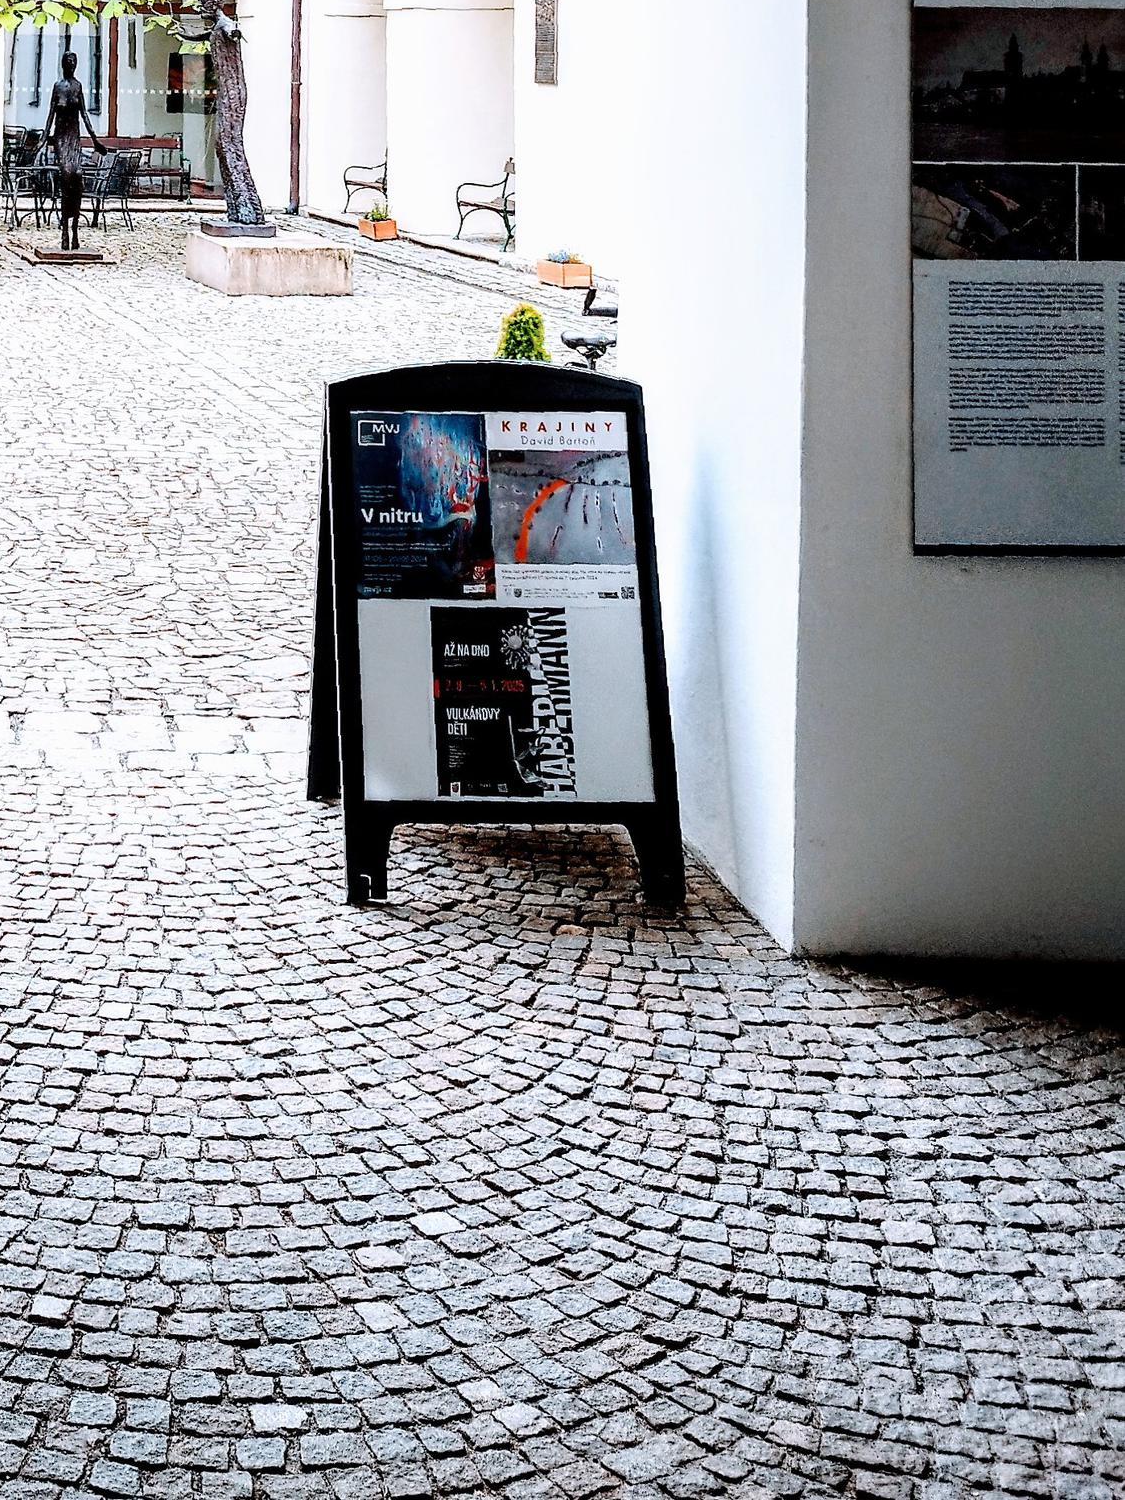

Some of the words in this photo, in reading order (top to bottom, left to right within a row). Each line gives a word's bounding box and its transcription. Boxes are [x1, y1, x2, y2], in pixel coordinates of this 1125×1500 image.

[372, 424, 400, 434] MVJ
[521, 435, 554, 446] David
[361, 508, 374, 523] V
[379, 508, 424, 523] nitru
[443, 641, 456, 657] AŽ
[457, 644, 470, 657] NA
[471, 644, 490, 657] DNO
[446, 706, 500, 720] VULKÁNOVY
[447, 720, 468, 736] DĚTI
